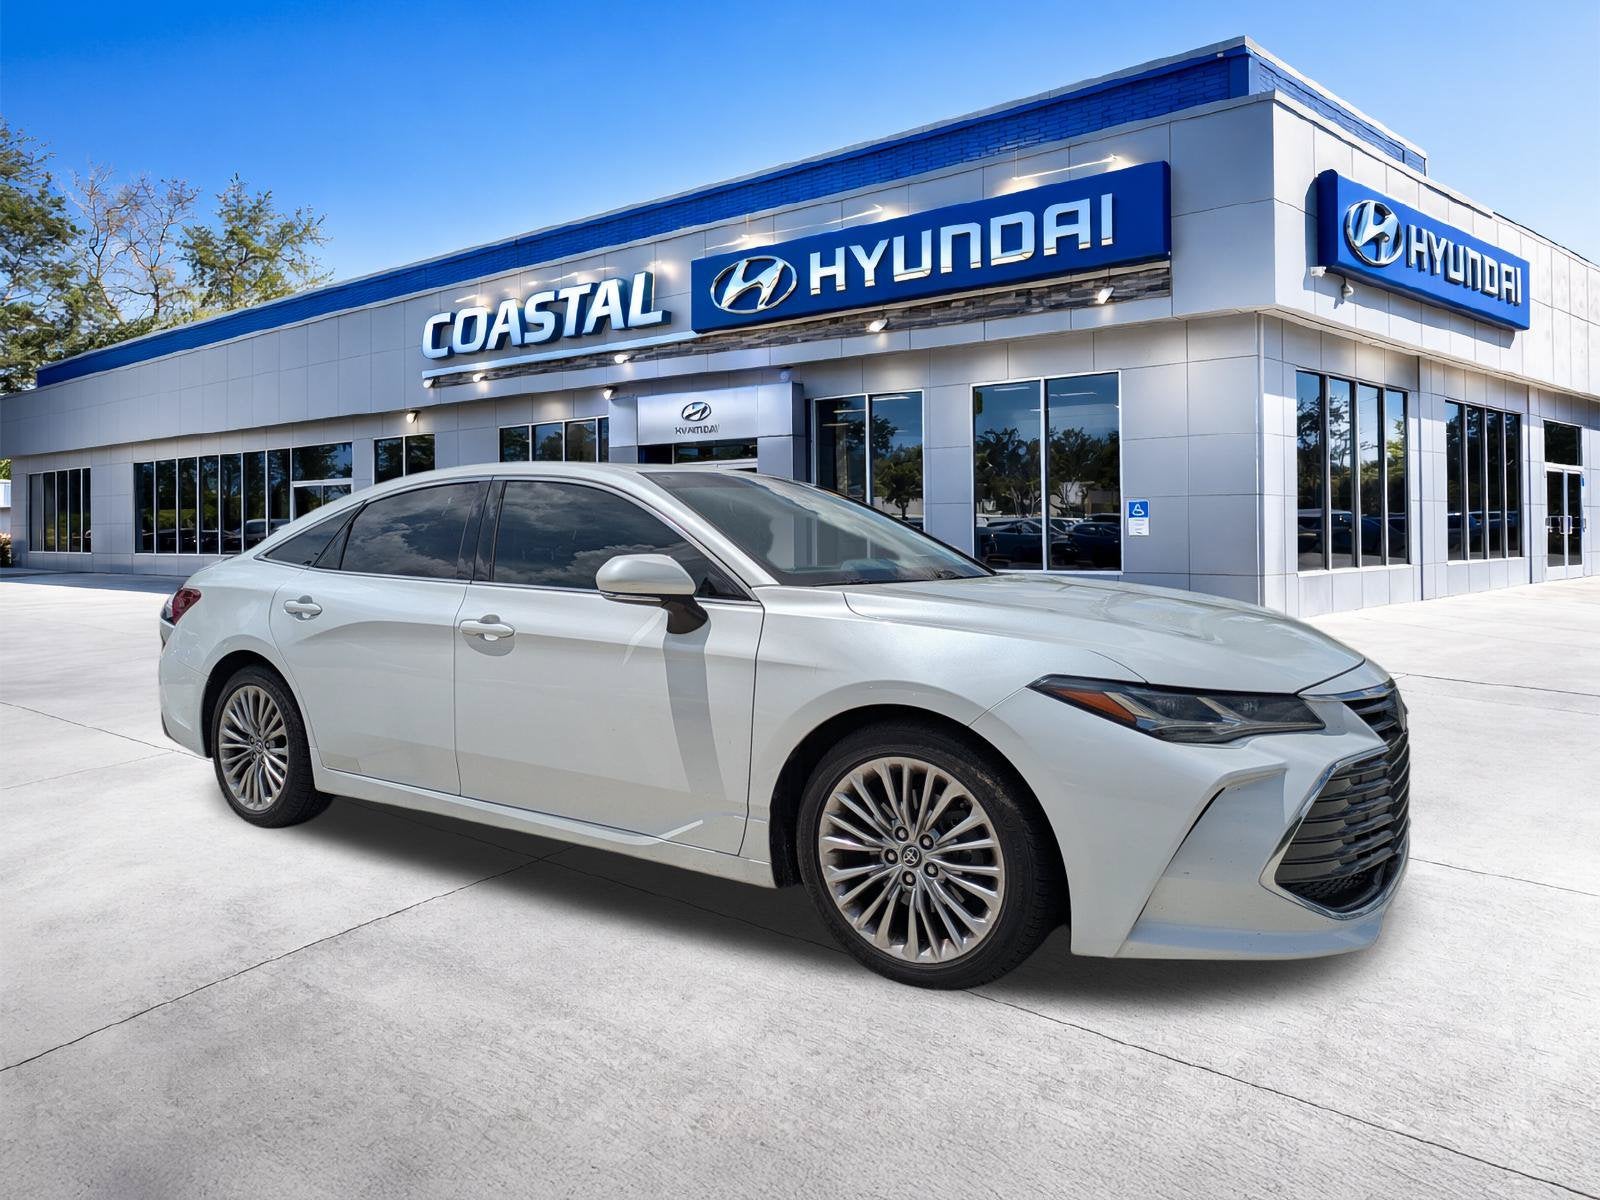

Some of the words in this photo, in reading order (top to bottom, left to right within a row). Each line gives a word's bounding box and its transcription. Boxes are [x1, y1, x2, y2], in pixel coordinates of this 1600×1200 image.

[809, 192, 1114, 296] HYUNDAI
[1406, 224, 1522, 306] HYUNDAI
[422, 271, 670, 360] COASTAL
